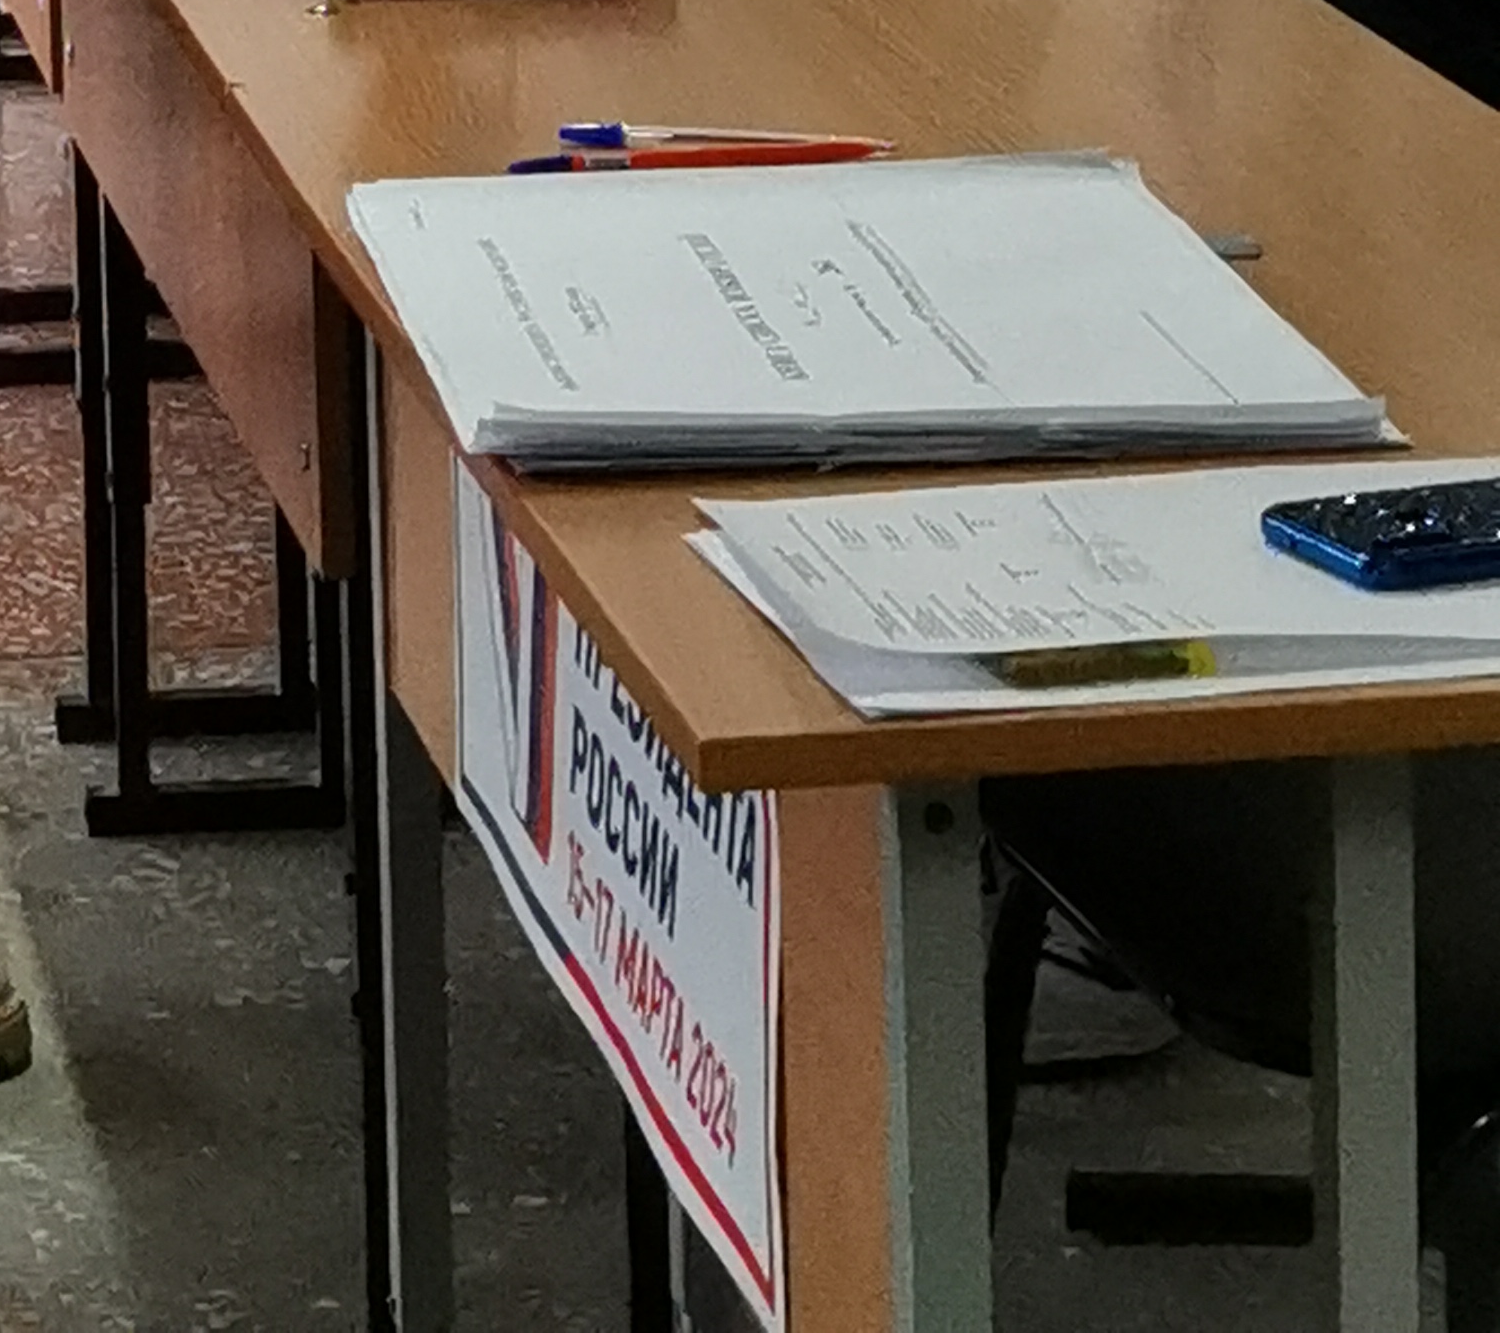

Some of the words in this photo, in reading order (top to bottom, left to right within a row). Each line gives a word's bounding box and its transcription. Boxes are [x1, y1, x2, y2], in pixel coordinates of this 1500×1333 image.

[570, 704, 679, 941] РОССИИ
[567, 831, 614, 966] 15-17
[615, 906, 683, 1082] МАРТА
[687, 1020, 737, 1170] 2024
